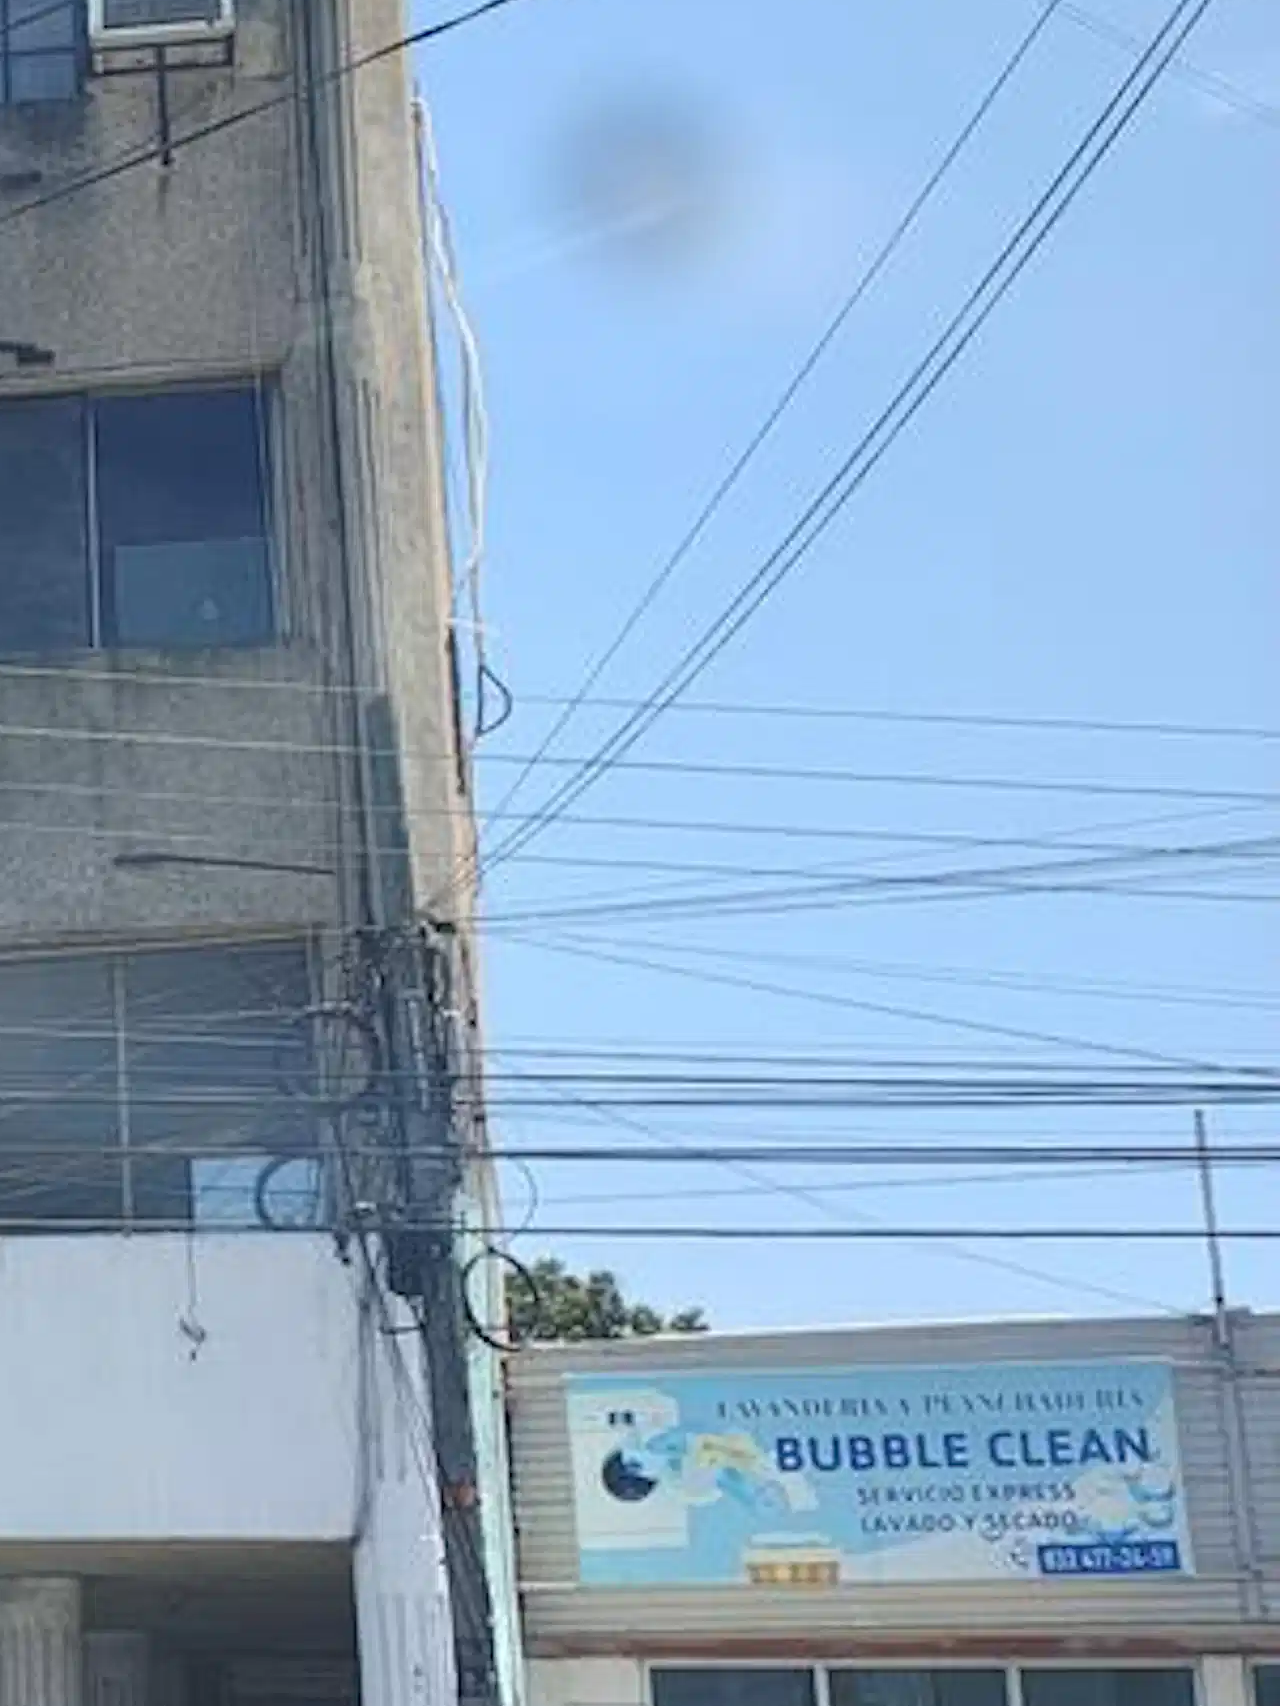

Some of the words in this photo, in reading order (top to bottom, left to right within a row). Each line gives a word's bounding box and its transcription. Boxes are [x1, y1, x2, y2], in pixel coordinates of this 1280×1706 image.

[775, 1432, 968, 1472] BUBBLE
[985, 1427, 1152, 1467] CLEAN
[856, 1483, 966, 1505] SERVICIO
[970, 1480, 1076, 1502] EXPRESS
[860, 1511, 957, 1534] LAVADO
[981, 1507, 1078, 1532] SECADO
